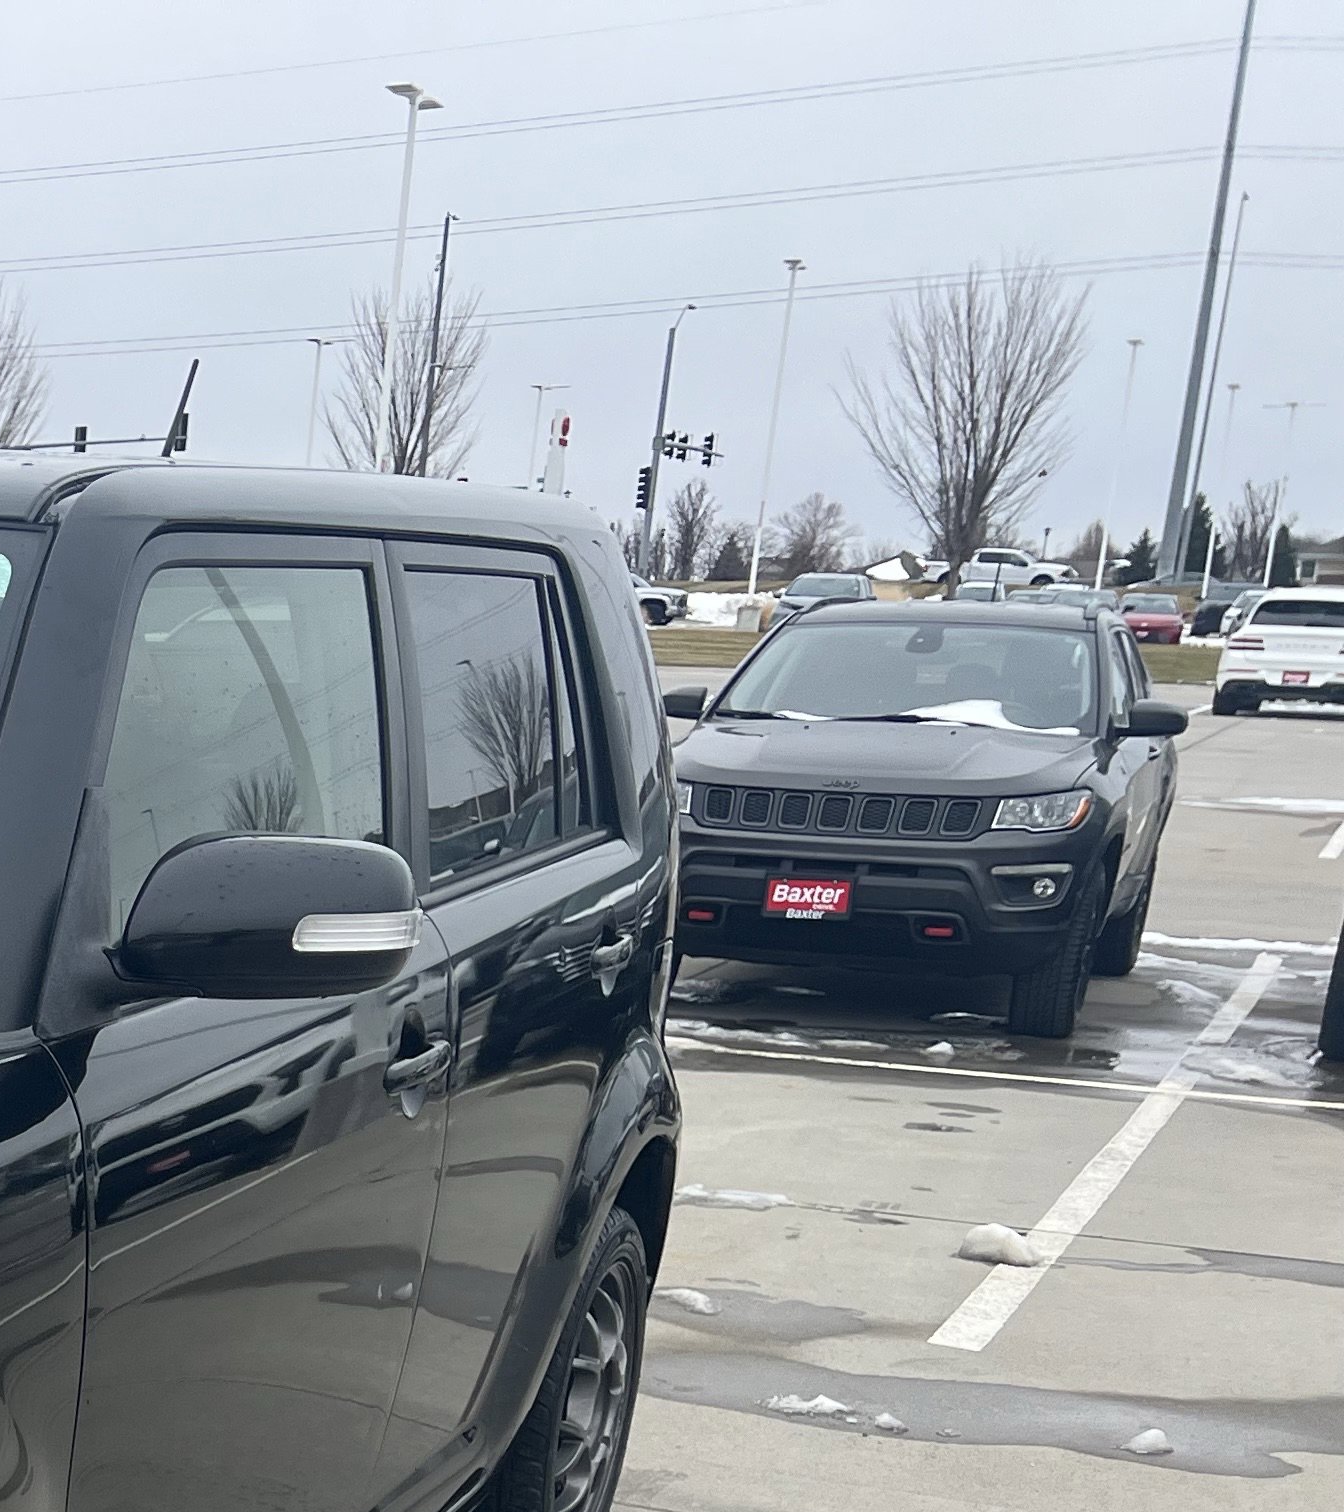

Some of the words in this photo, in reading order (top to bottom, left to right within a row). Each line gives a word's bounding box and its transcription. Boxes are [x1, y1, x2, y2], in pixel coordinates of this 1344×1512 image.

[822, 778, 860, 790] Jeep
[772, 884, 845, 904] Baxter
[785, 907, 826, 919] Baxter
